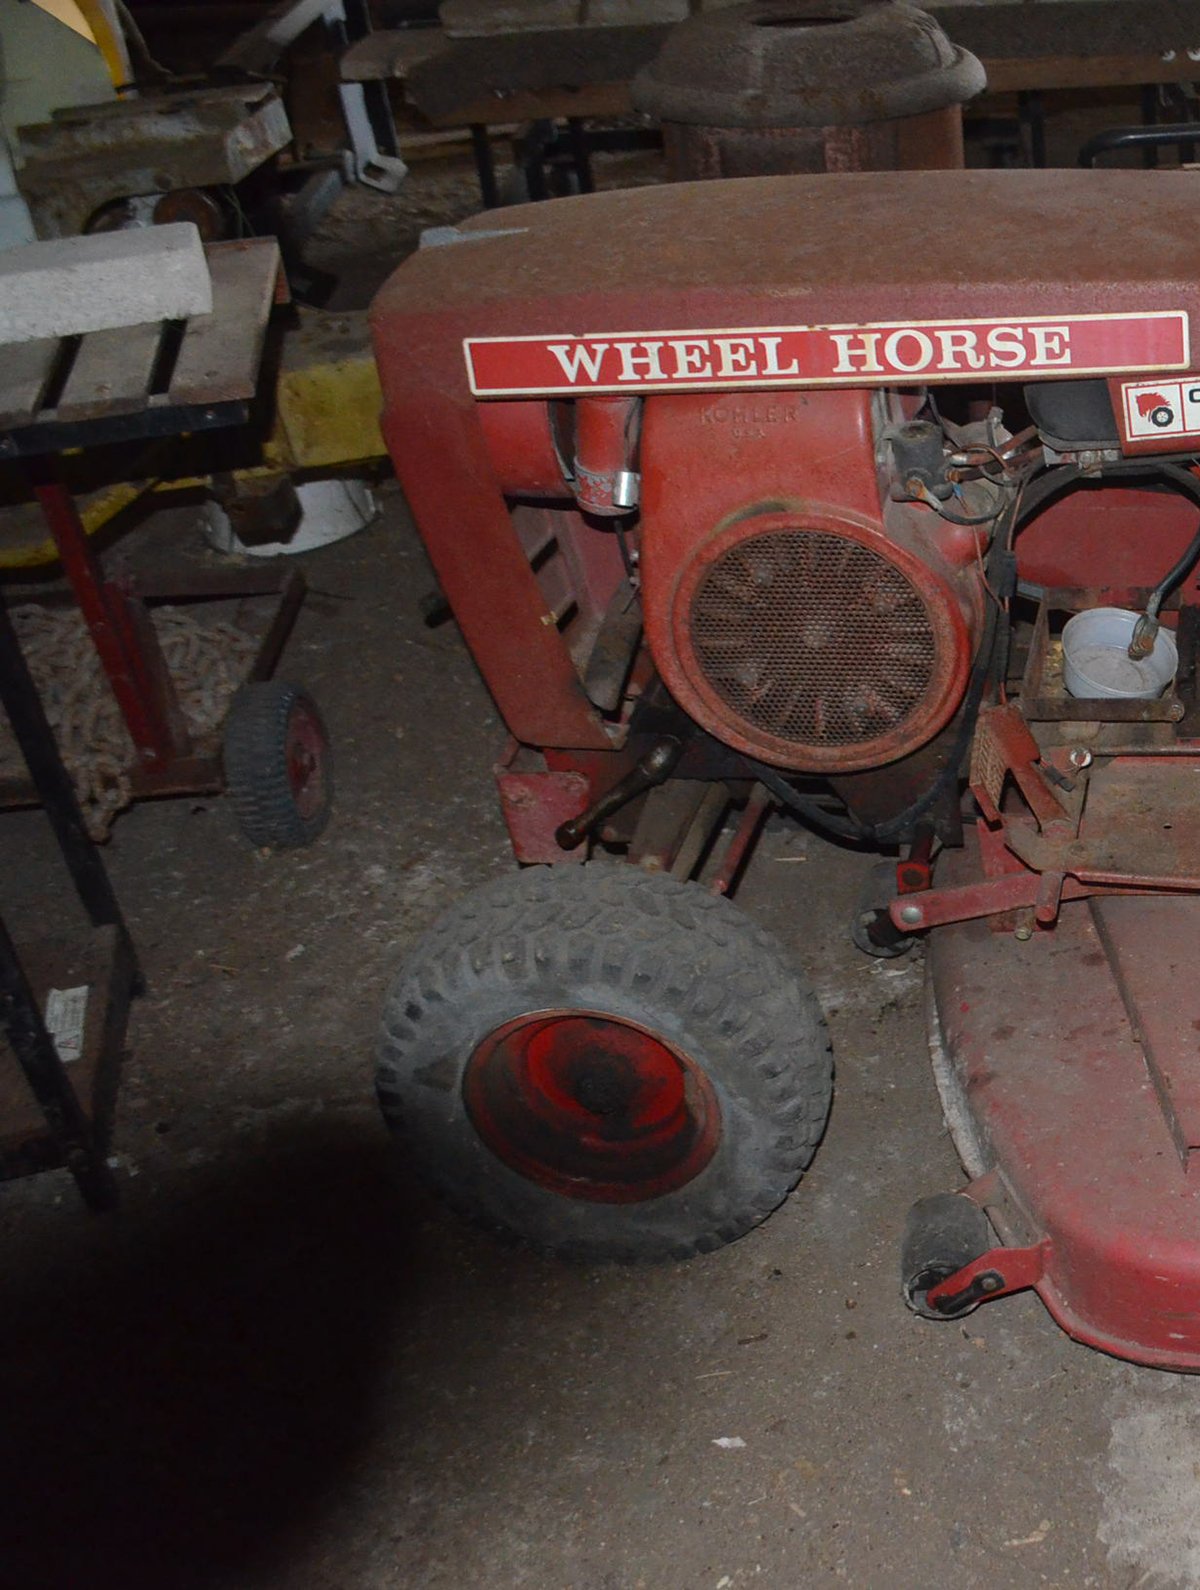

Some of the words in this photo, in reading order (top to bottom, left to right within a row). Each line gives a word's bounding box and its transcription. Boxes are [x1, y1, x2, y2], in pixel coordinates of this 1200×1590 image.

[547, 337, 799, 383] WHEEL
[830, 326, 1072, 372] HORSE
[700, 405, 799, 424] KOHLER
